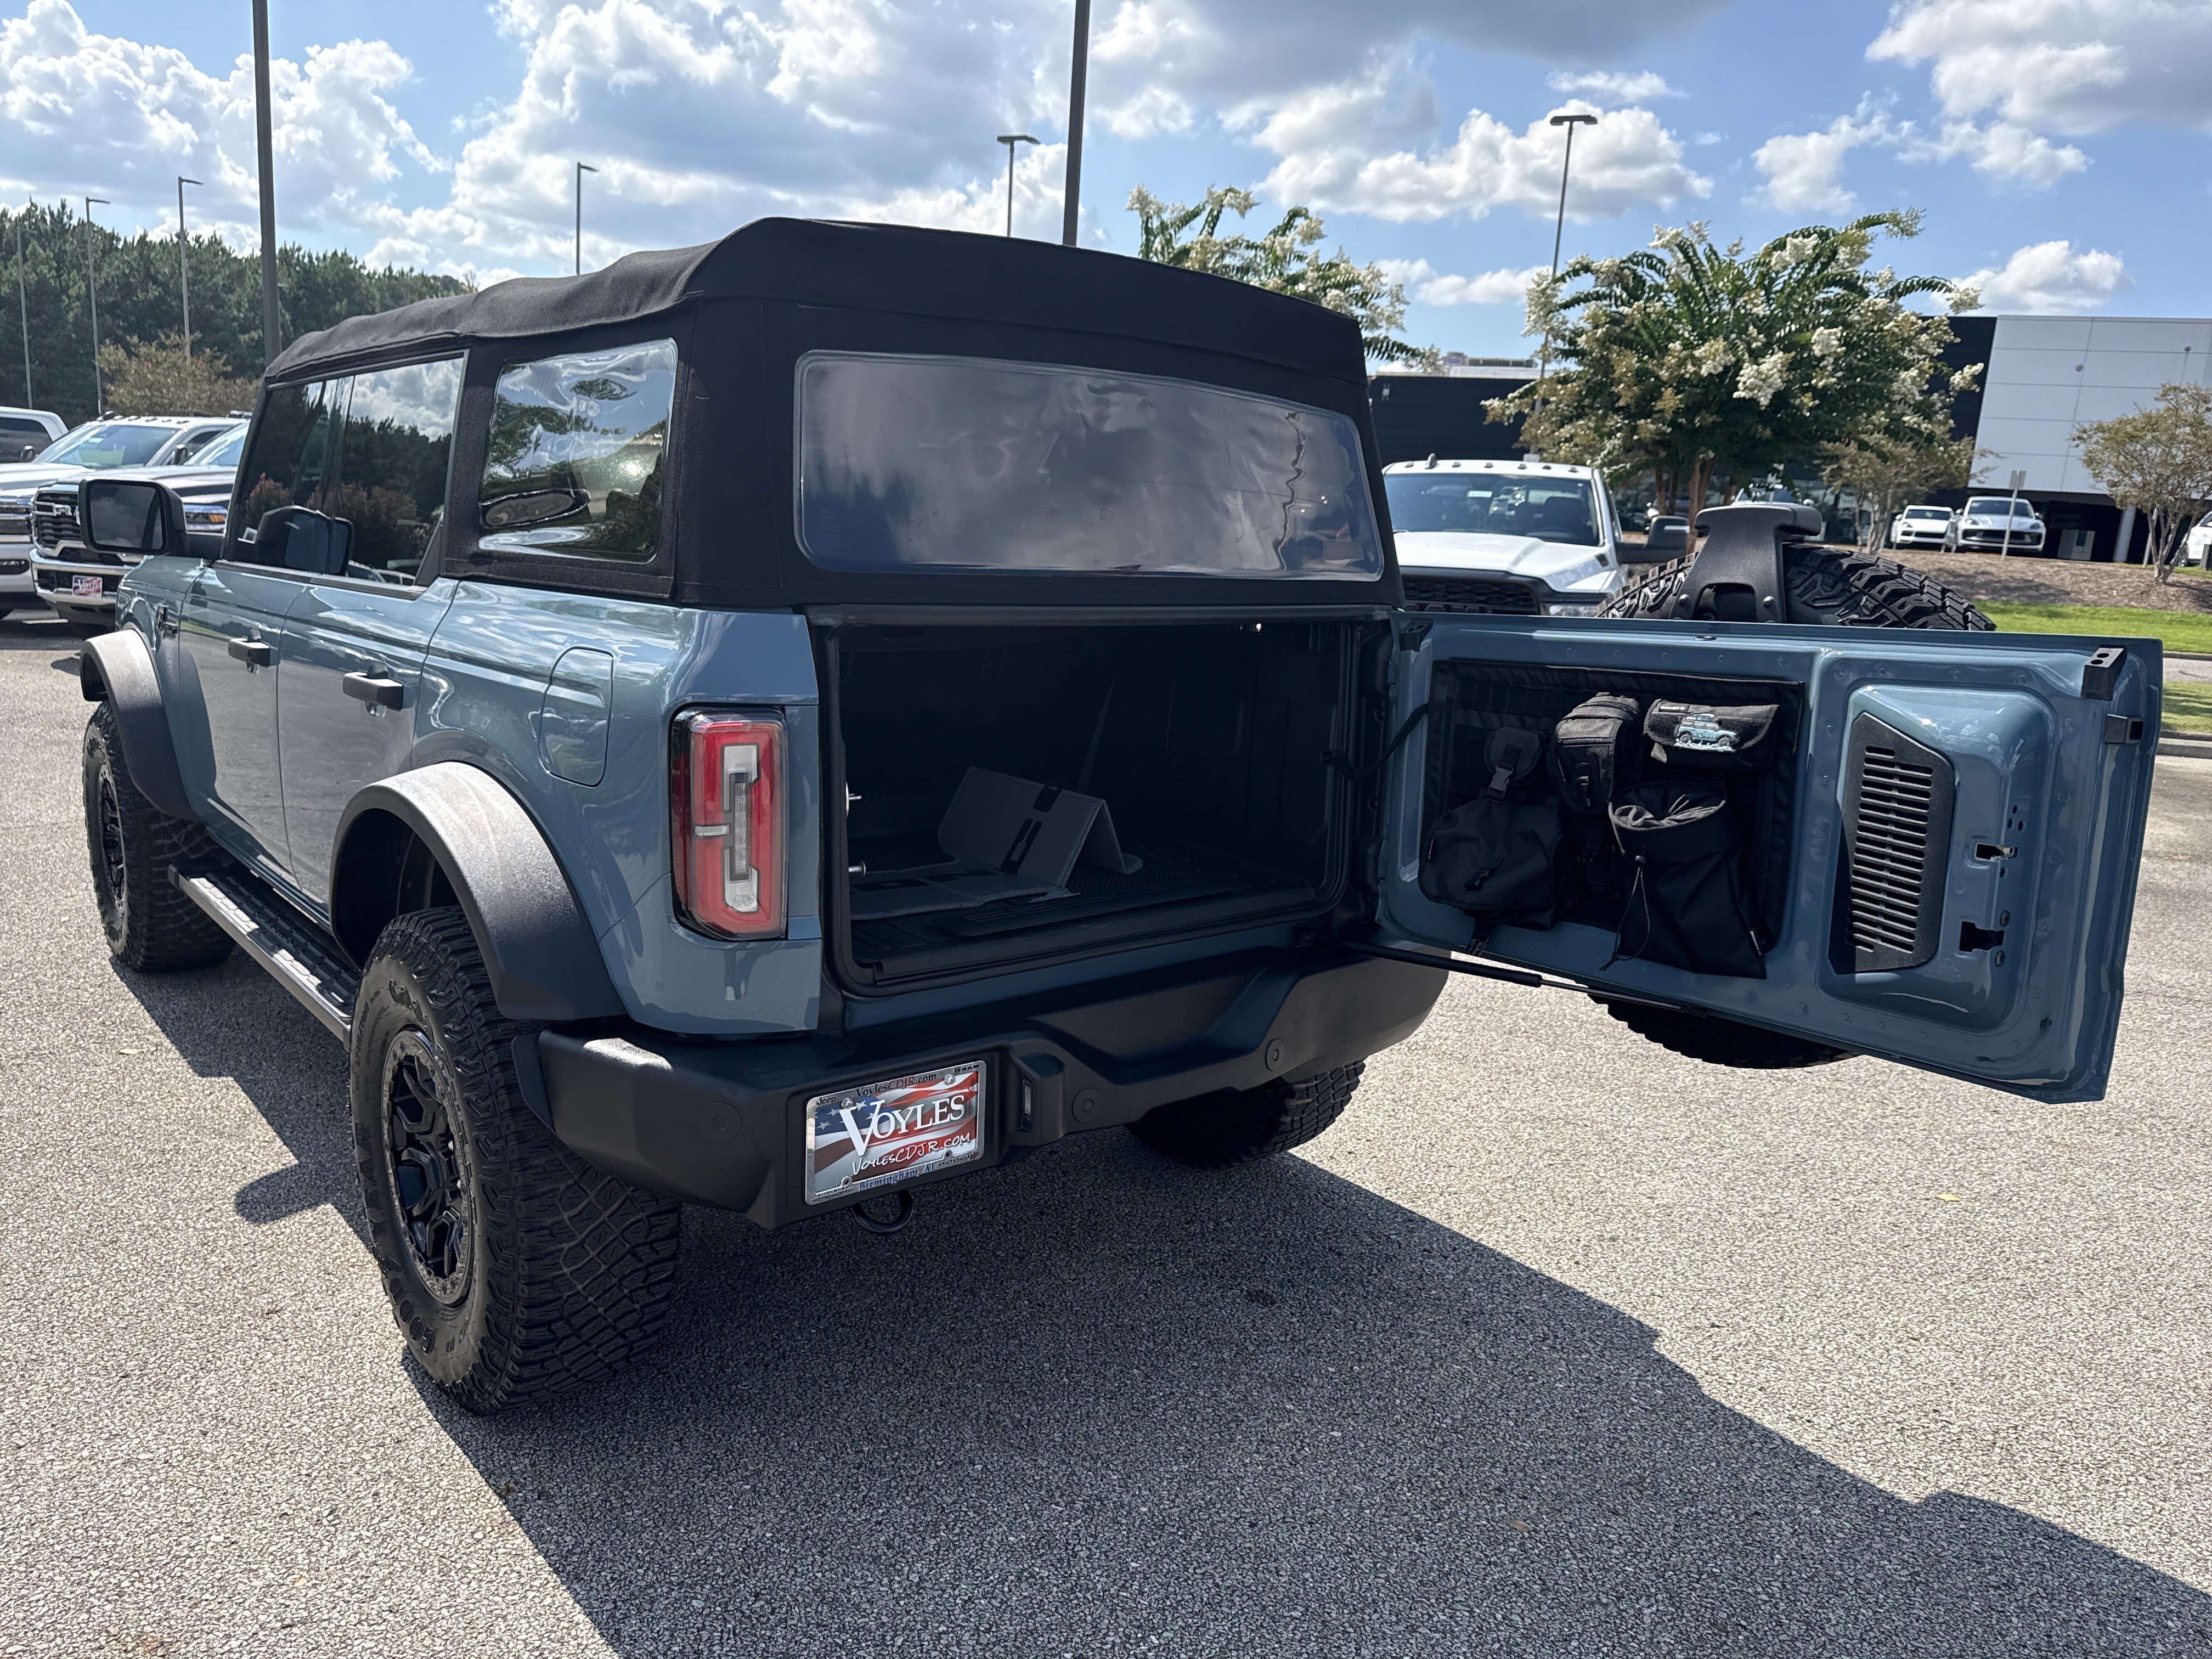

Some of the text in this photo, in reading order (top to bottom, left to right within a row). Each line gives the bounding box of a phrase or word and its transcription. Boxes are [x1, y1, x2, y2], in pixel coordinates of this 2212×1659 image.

[856, 1074, 936, 1097] VoylesCDJR.com
[816, 1096, 836, 1105] Jeep
[839, 1095, 965, 1156] VOYLES
[859, 1163, 936, 1190] Birmingham, AL
